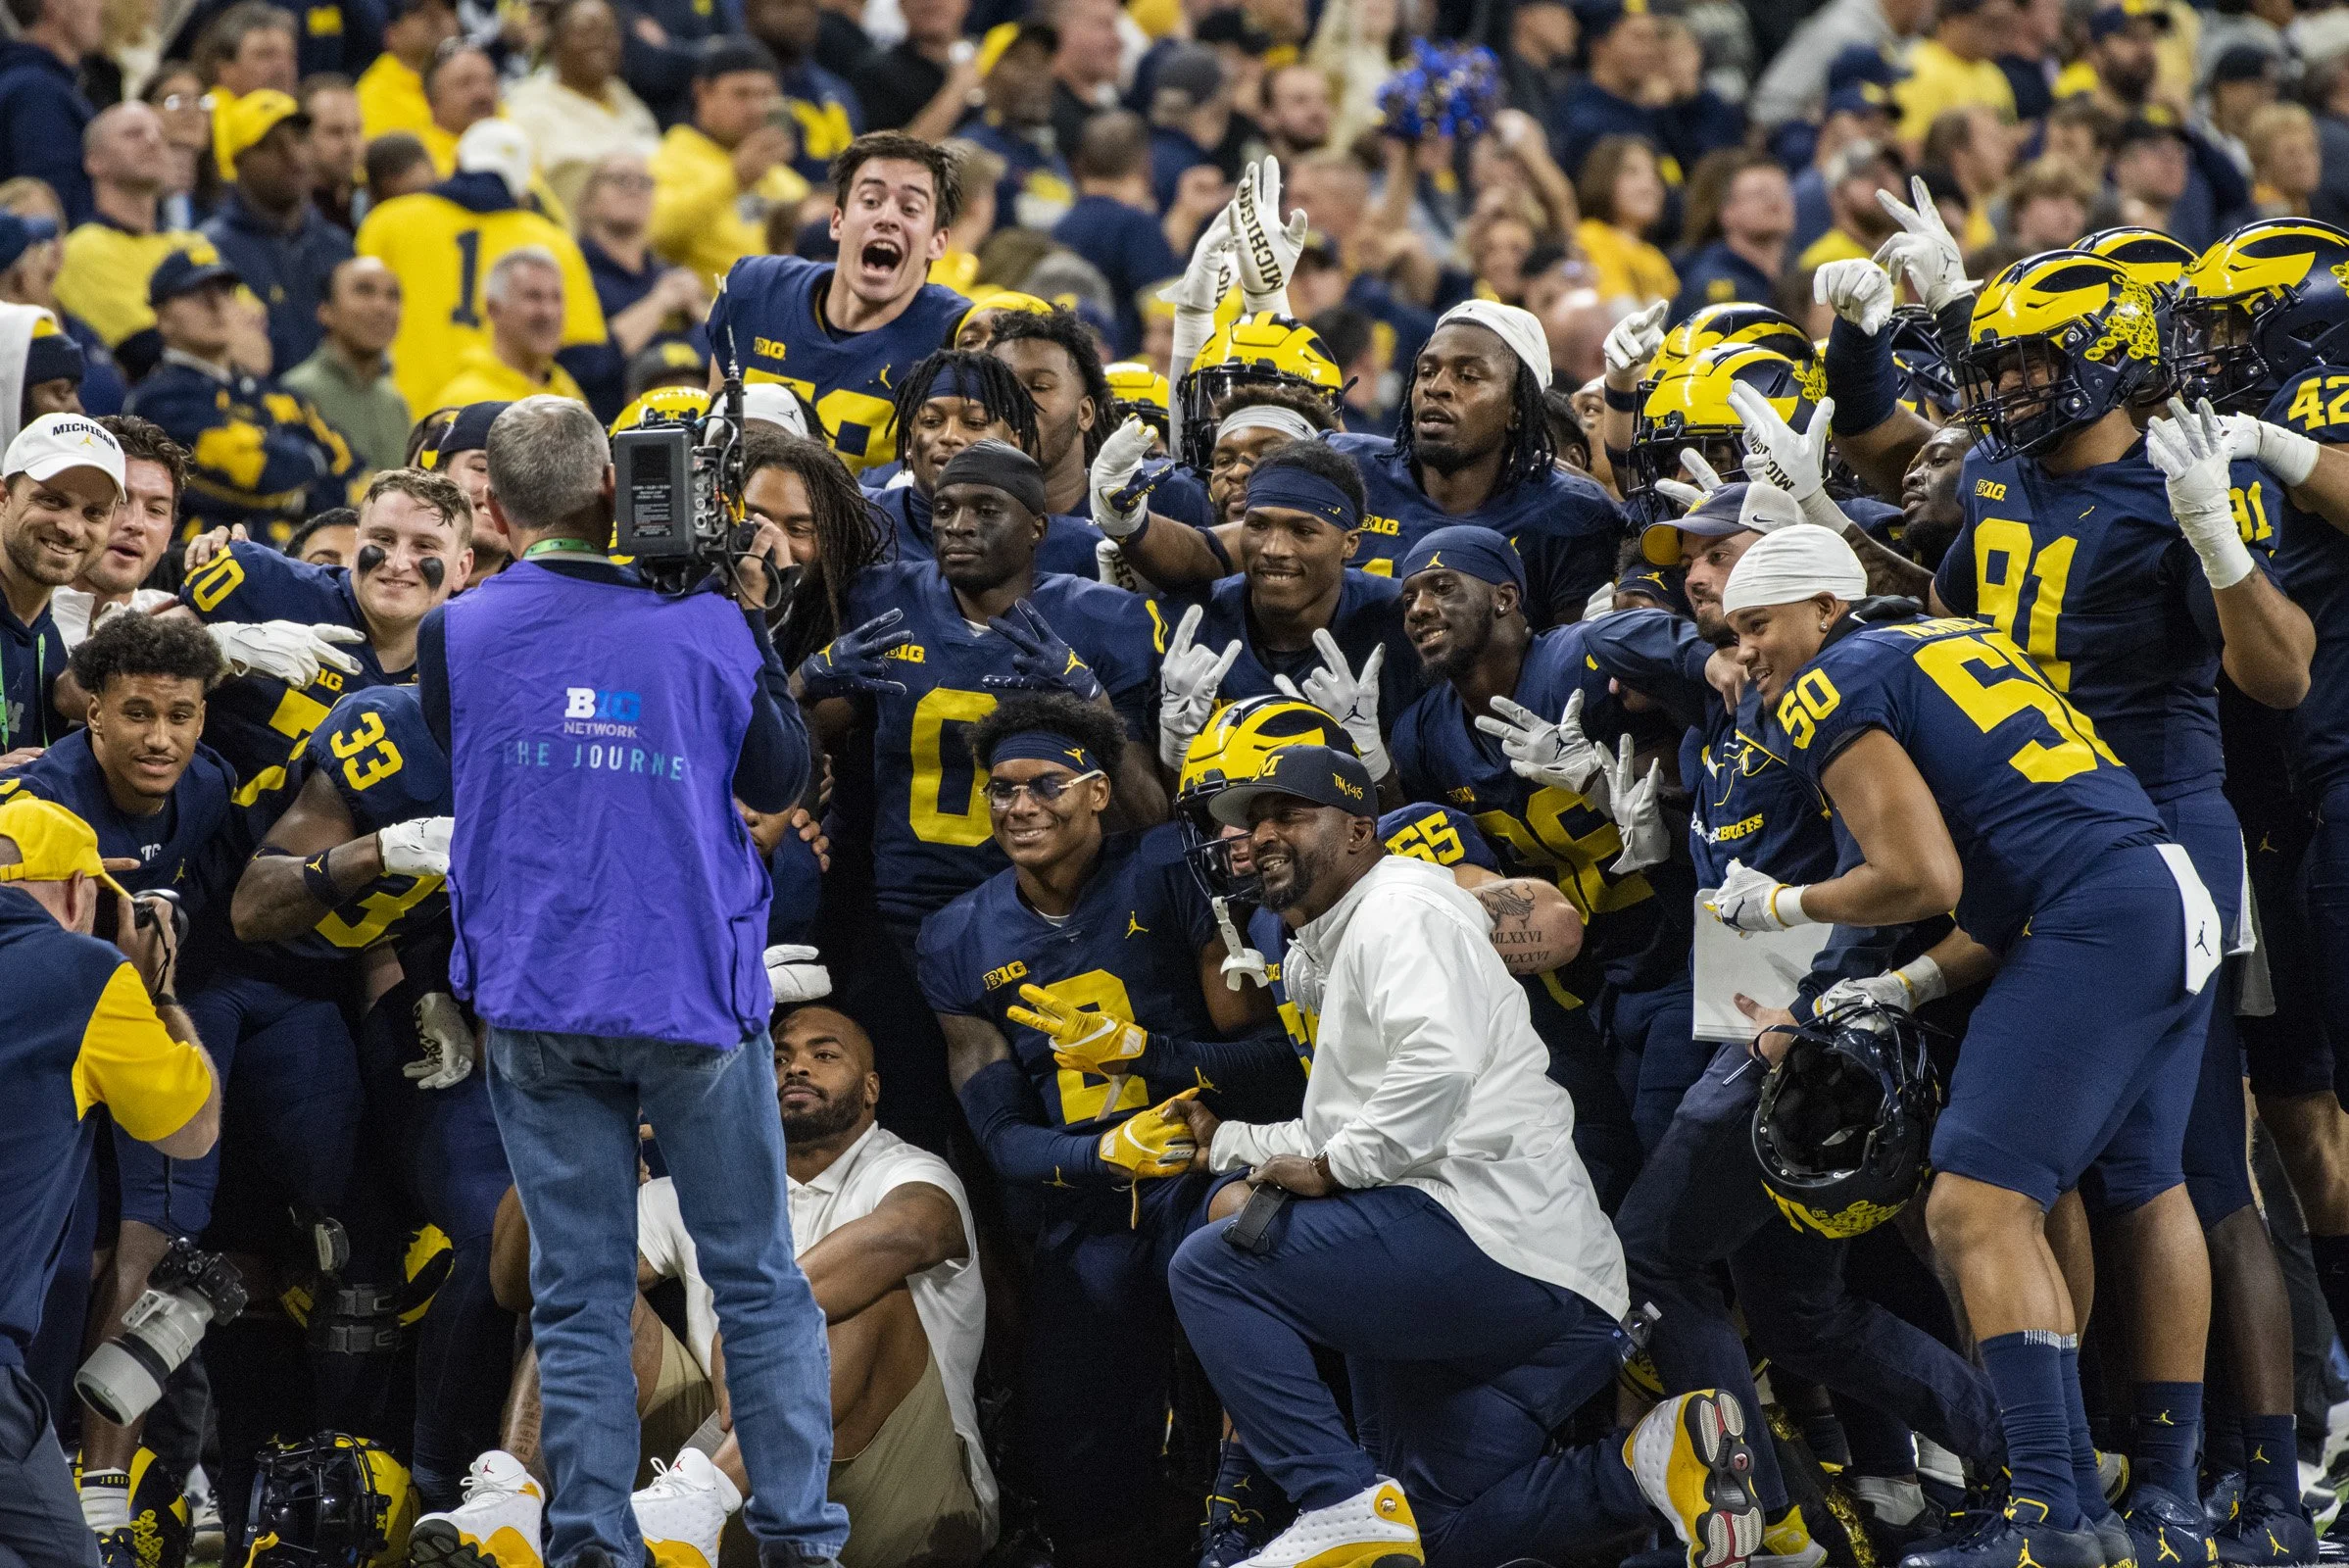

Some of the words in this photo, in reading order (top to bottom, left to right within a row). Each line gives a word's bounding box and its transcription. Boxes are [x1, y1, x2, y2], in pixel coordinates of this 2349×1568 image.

[52, 422, 116, 450] MICHIGAN
[2288, 376, 2349, 430] 42
[1975, 517, 2079, 693] 91
[564, 722, 637, 738] NETWORK
[1777, 667, 1840, 749] 50
[330, 711, 403, 791] 33
[909, 687, 999, 847] 0
[1252, 756, 1284, 782] M
